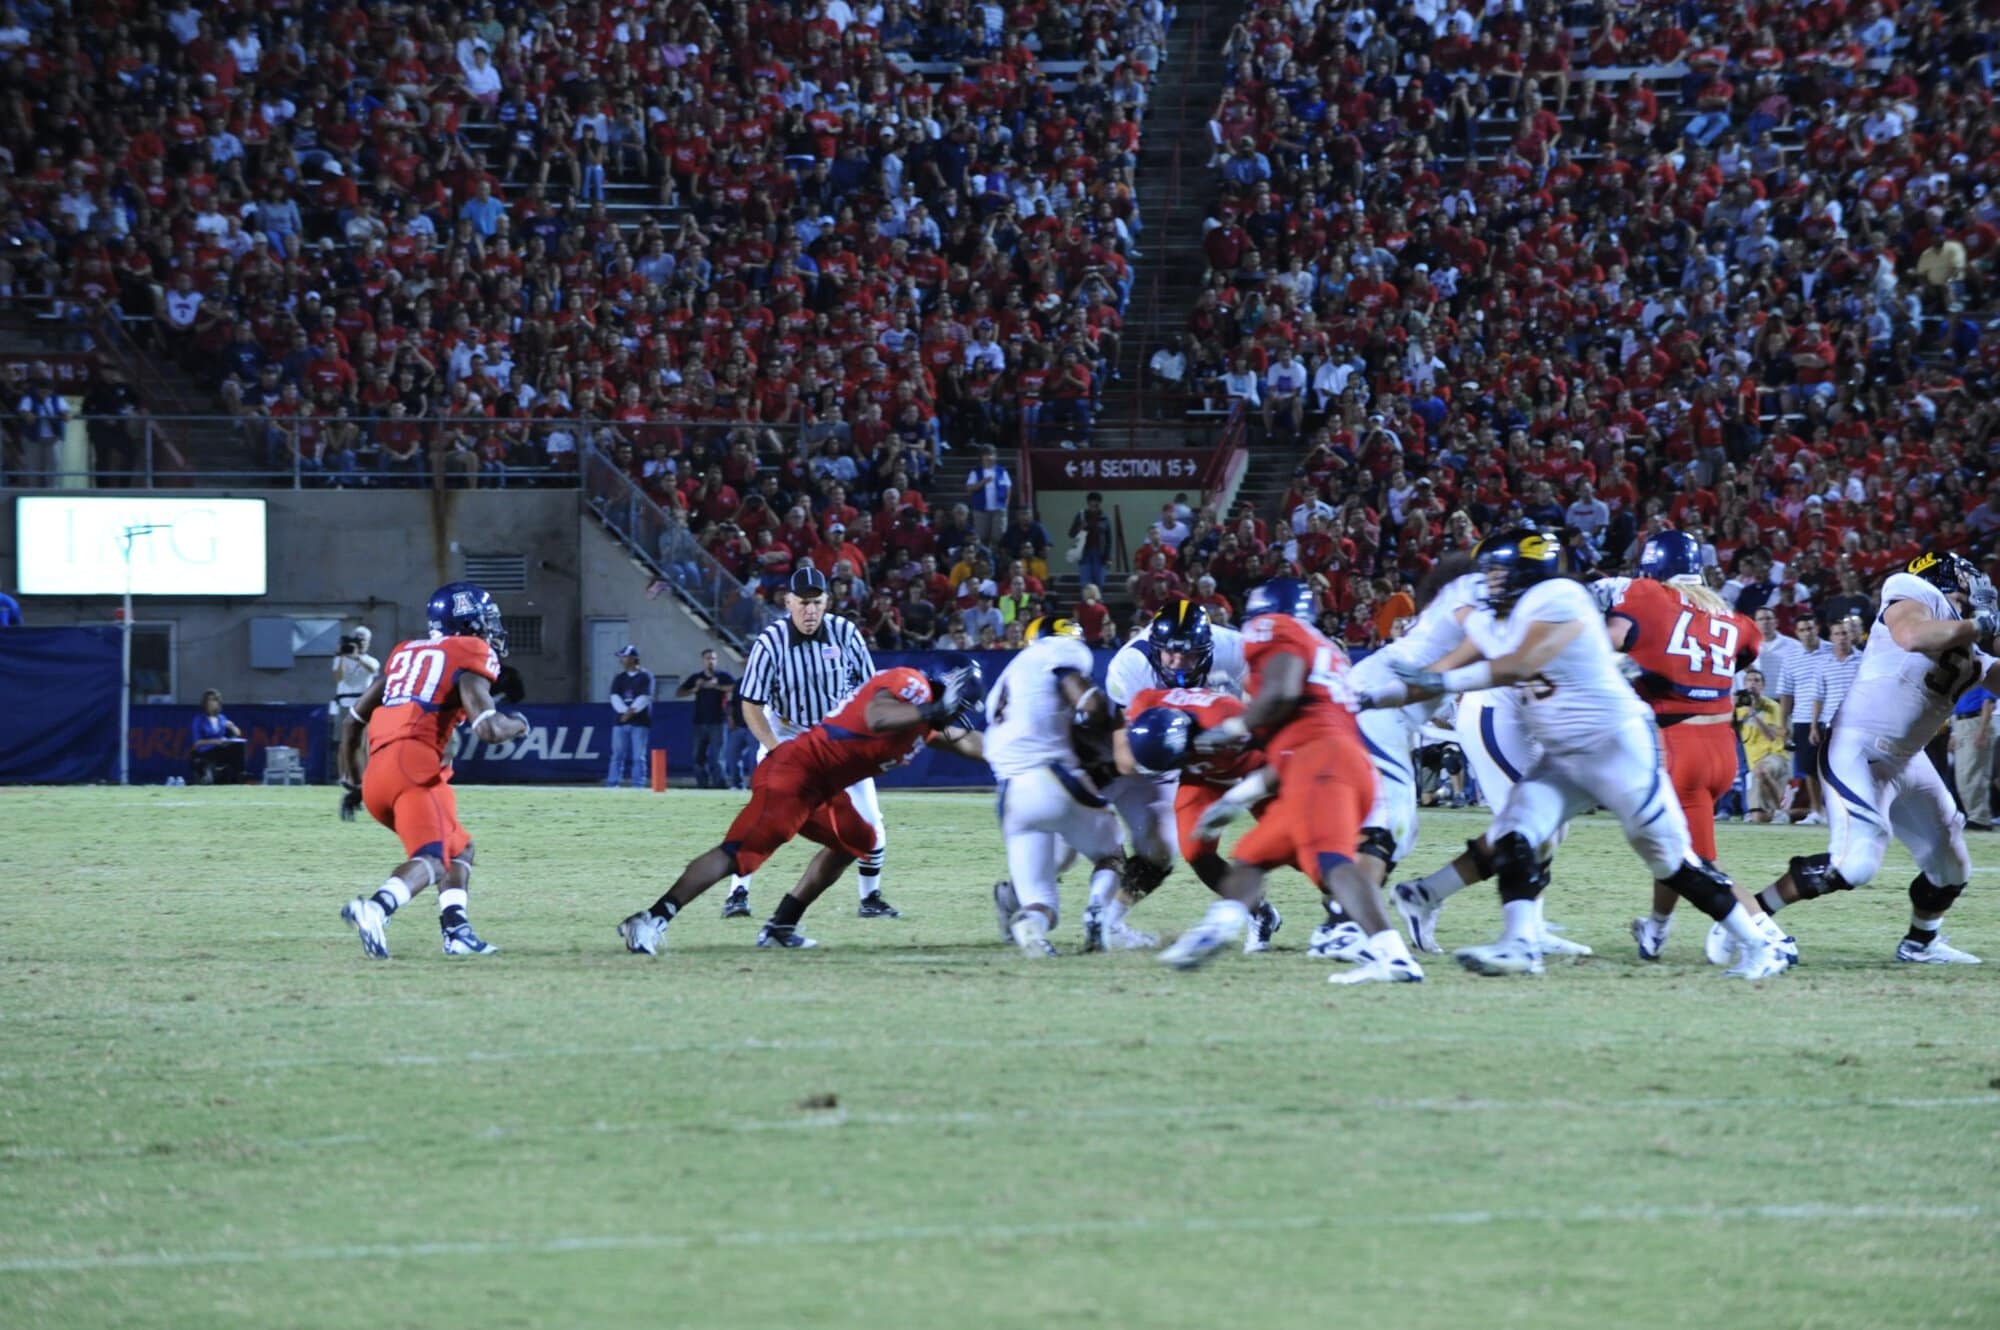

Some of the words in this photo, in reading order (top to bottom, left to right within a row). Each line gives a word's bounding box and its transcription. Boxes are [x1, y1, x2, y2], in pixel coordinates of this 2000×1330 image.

[1080, 460, 1096, 477] 14
[1100, 459, 1162, 477] SECTION
[1166, 459, 1182, 477] 15
[1908, 552, 1938, 575] Cal
[1666, 610, 1739, 678] 42
[382, 648, 446, 707] 20
[128, 726, 309, 760] ARINA
